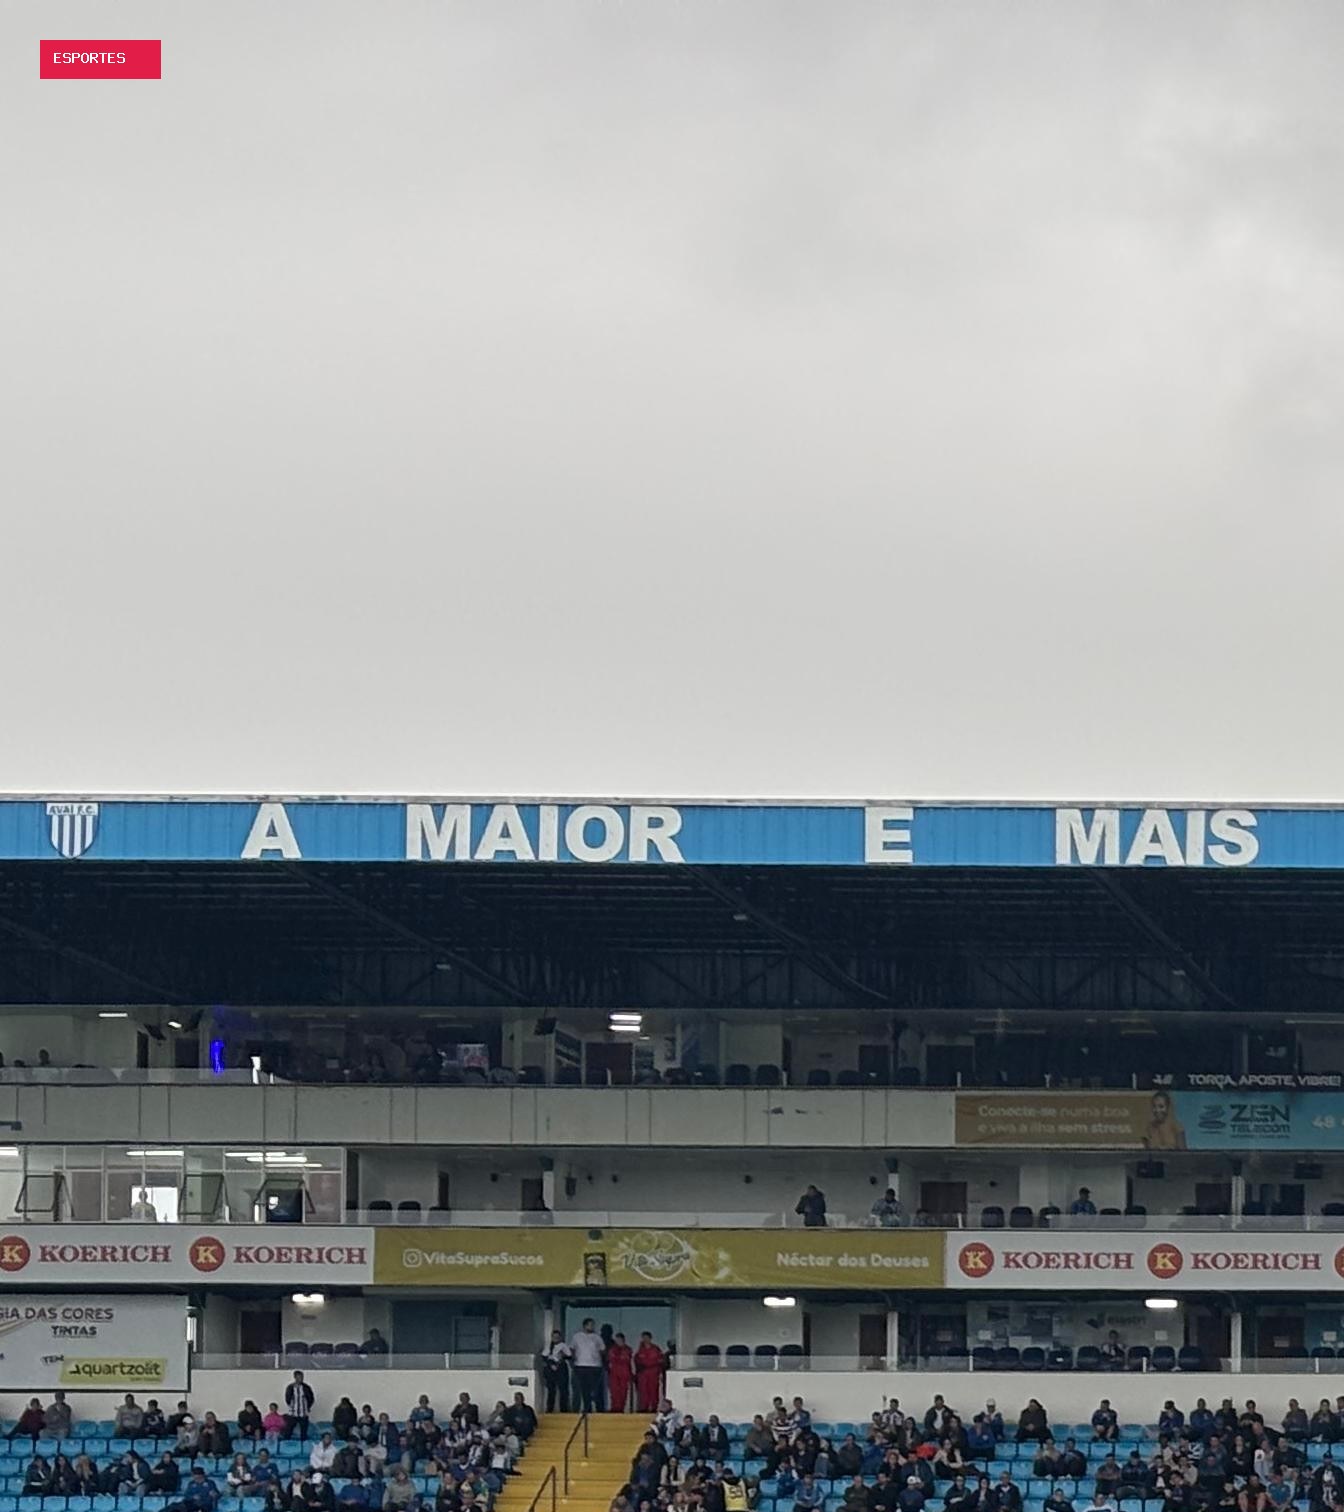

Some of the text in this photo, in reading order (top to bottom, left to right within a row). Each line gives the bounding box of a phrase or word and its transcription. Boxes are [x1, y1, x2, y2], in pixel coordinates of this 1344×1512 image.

[240, 803, 302, 860] A
[405, 804, 684, 863] MAIOR
[864, 806, 915, 863] E
[1053, 805, 1260, 866] MAIS
[1230, 1104, 1290, 1122] ZEN
[1312, 1116, 1336, 1128] 48
[38, 1244, 172, 1263] KOERICH
[233, 1245, 367, 1265] KOERICH
[423, 1252, 544, 1268] VitaSupraSucos
[838, 1252, 867, 1267] dos
[870, 1253, 929, 1268] Deuses
[1001, 1250, 1135, 1271] KOERICH
[1190, 1251, 1322, 1272] KOERICH
[25, 1307, 57, 1320] DAS
[62, 1307, 114, 1320] CORES
[51, 1325, 97, 1336] TINTAS
[82, 1361, 161, 1377] quartzolit
